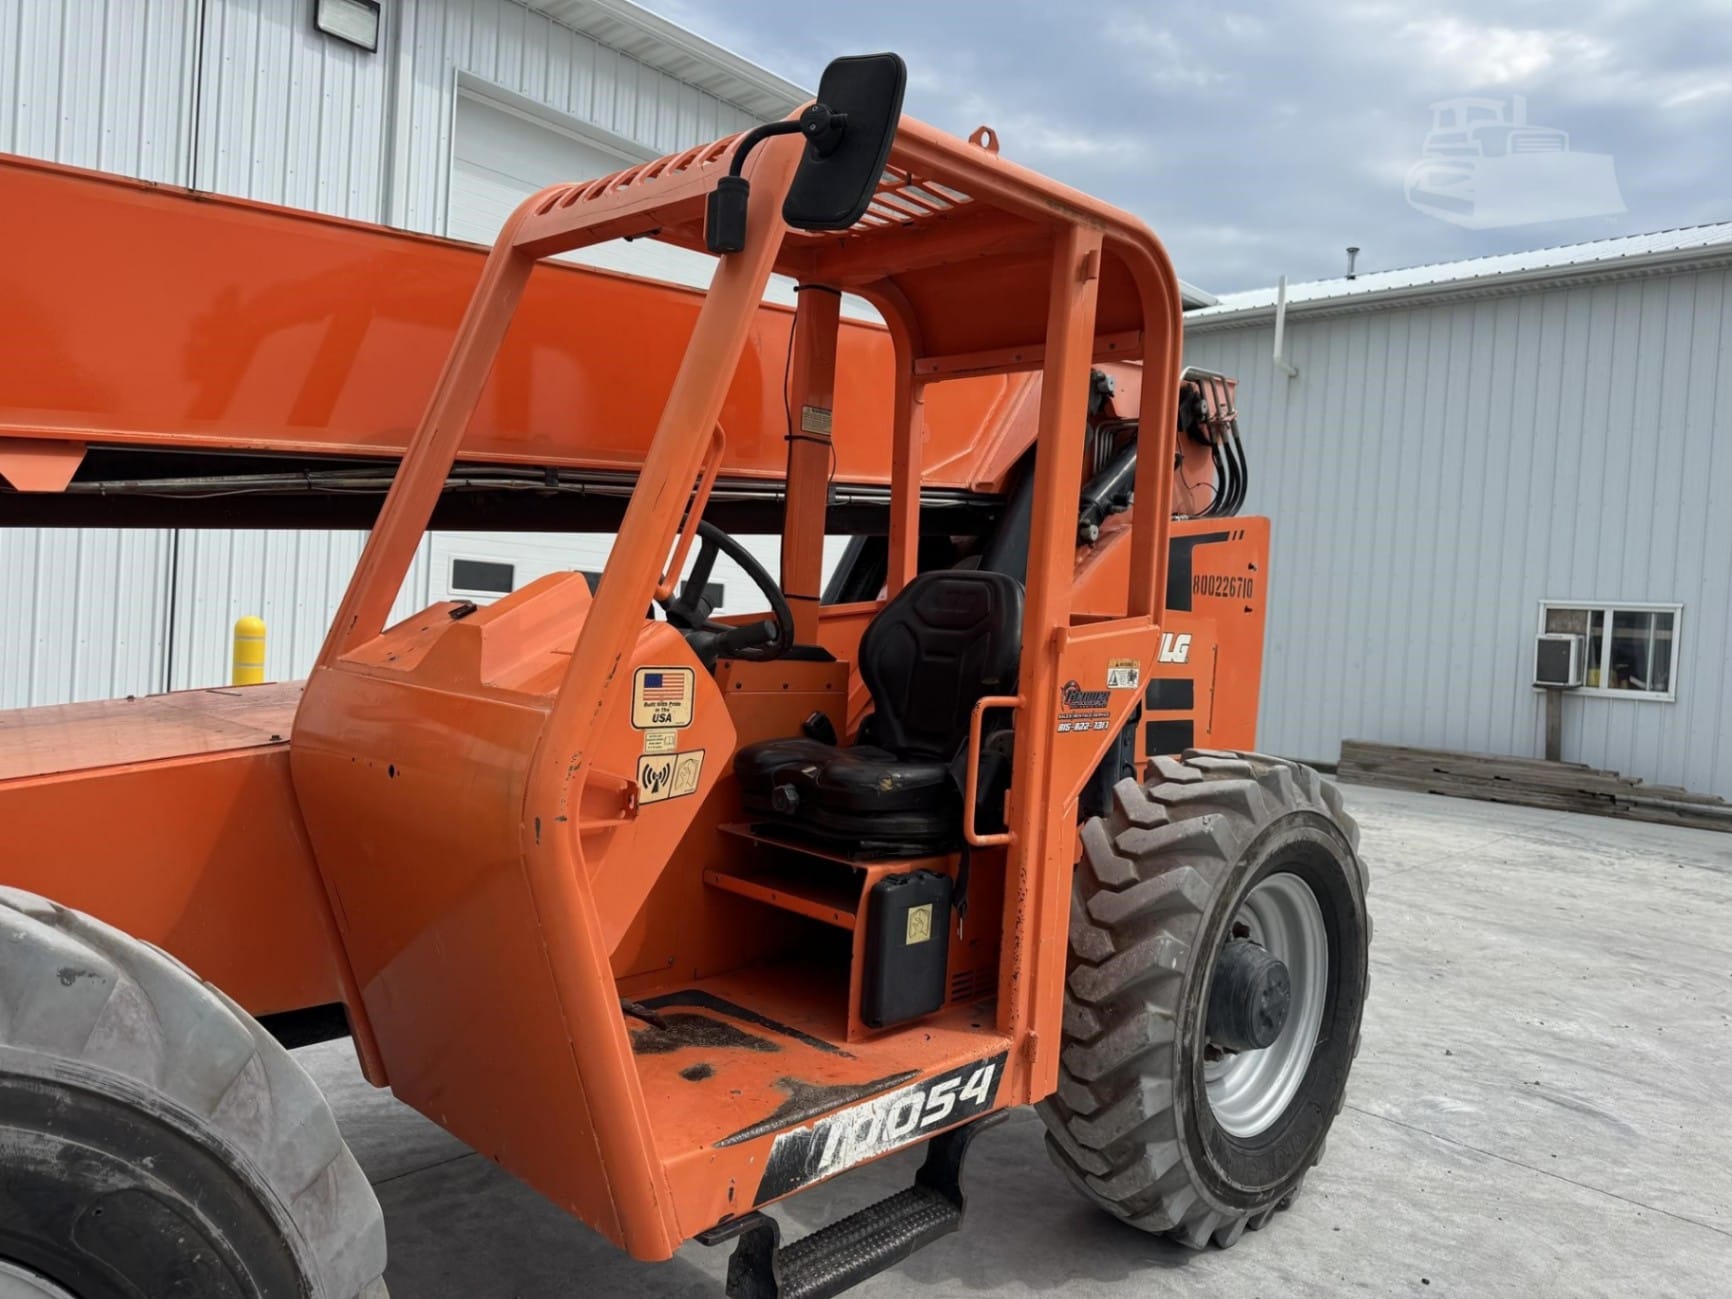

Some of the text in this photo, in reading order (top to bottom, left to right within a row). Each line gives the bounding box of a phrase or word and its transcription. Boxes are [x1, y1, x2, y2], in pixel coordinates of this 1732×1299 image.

[1193, 575, 1253, 598] 800226710
[1158, 632, 1192, 662] LG
[652, 713, 671, 723] USA
